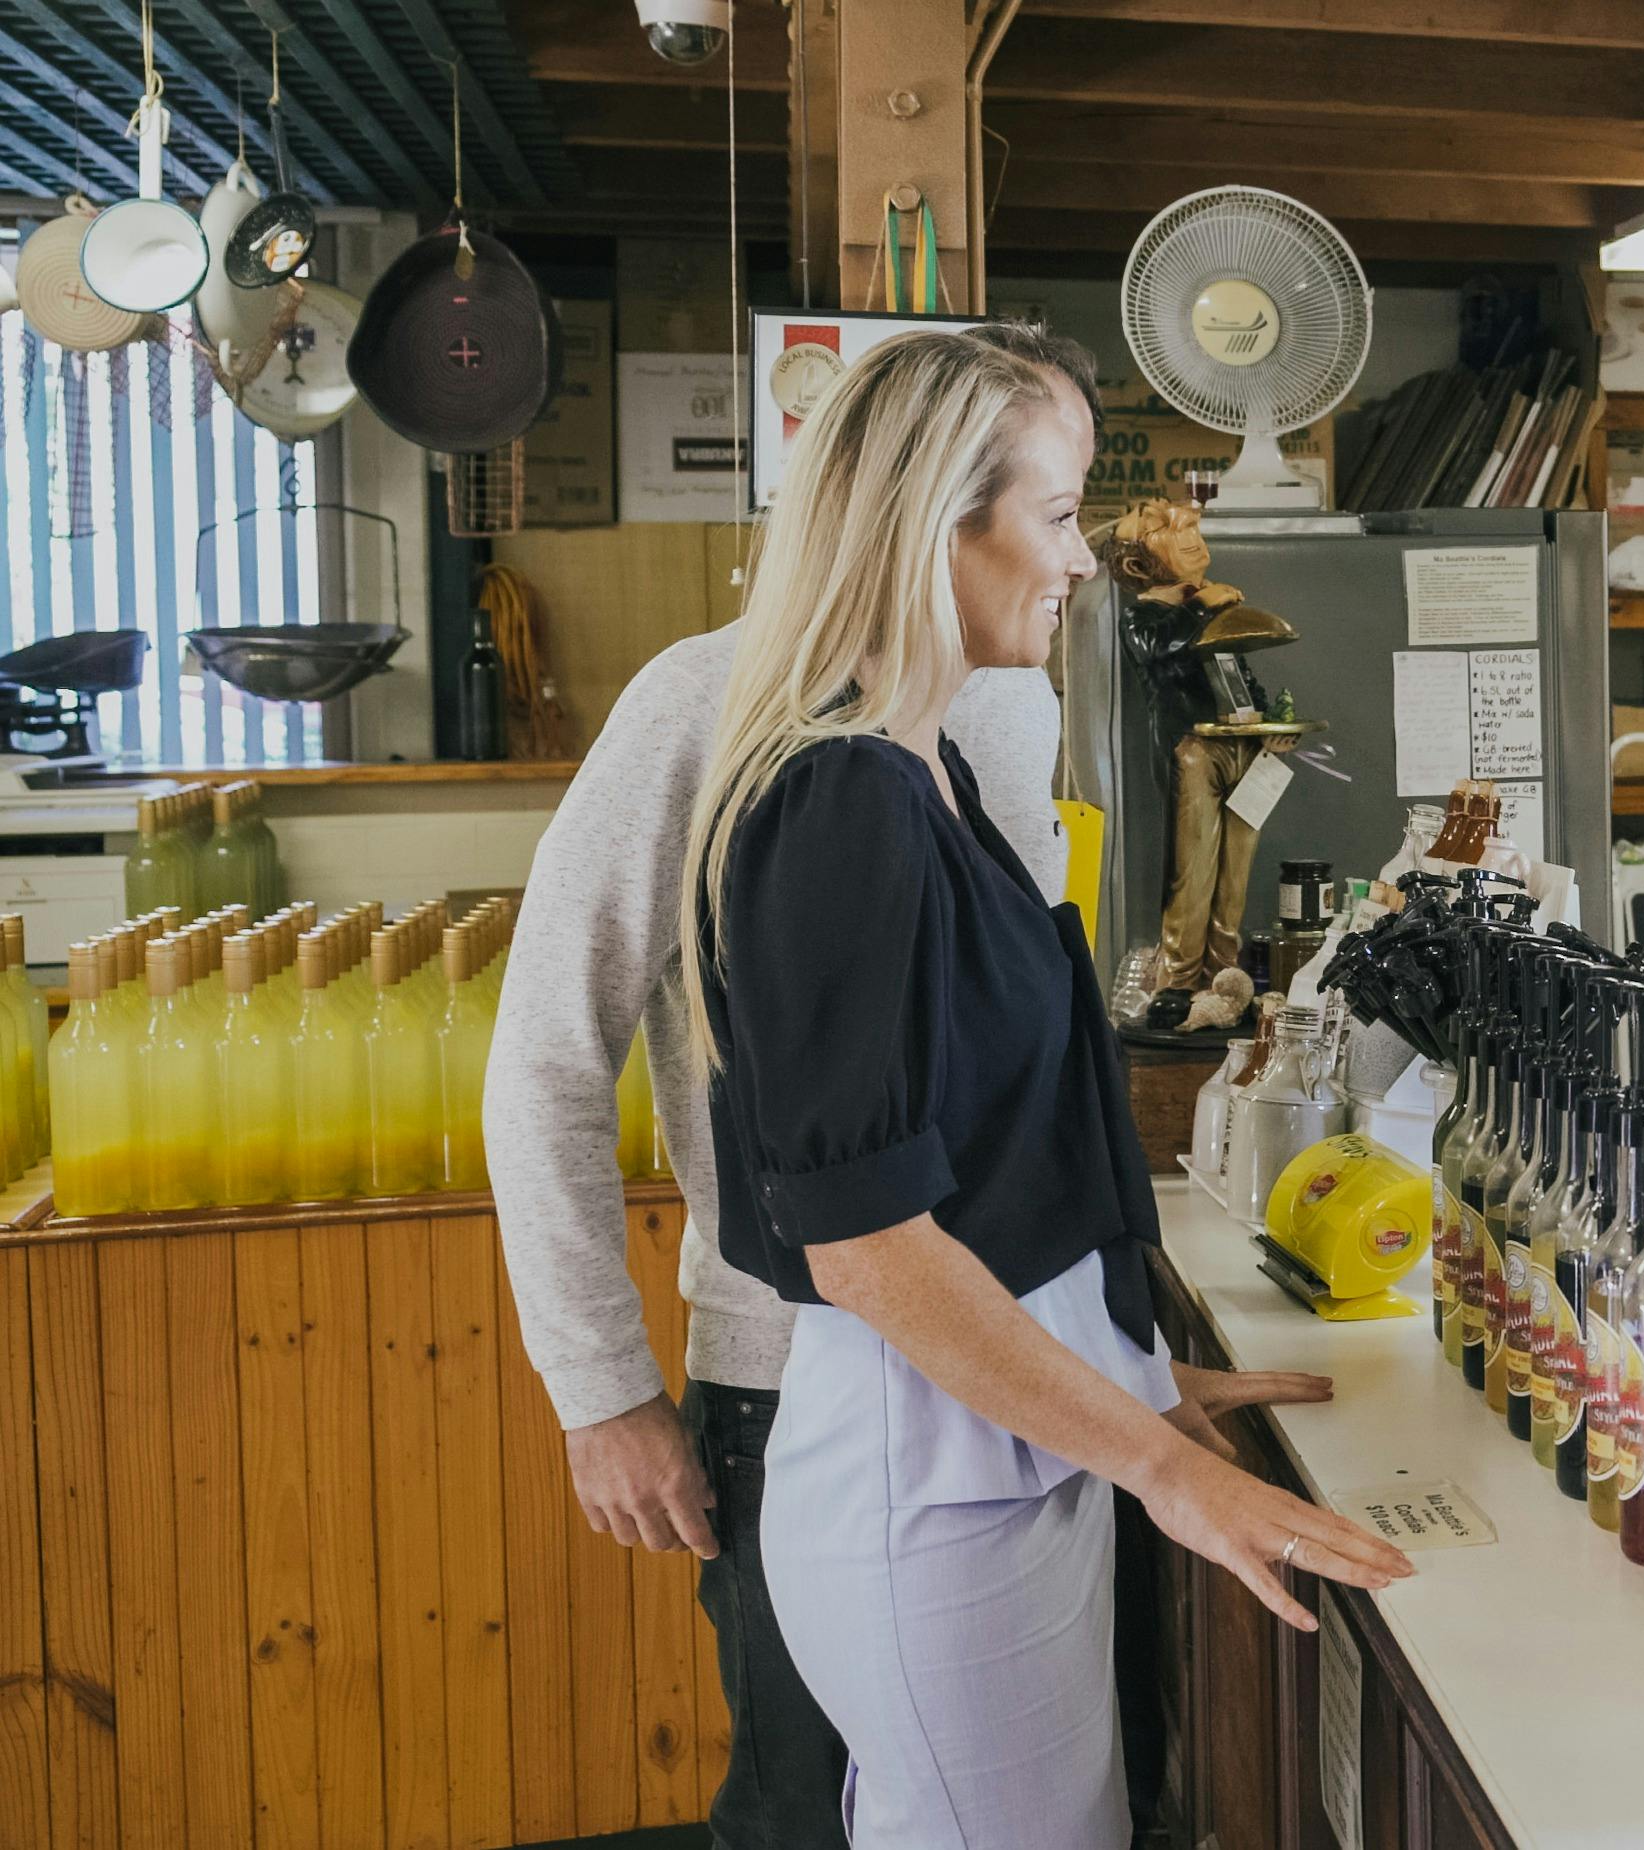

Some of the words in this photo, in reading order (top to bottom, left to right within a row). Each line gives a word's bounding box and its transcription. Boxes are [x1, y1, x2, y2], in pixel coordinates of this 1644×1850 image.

[779, 351, 803, 374] LOCAL
[804, 348, 842, 377] BUSINESS
[1086, 457, 1156, 482] OAM
[1474, 654, 1534, 665] CORDIALS
[1483, 765, 1507, 774] Made
[1376, 1231, 1406, 1246] Lipton
[1365, 1504, 1390, 1519] $10
[1393, 1503, 1428, 1534] Cordials
